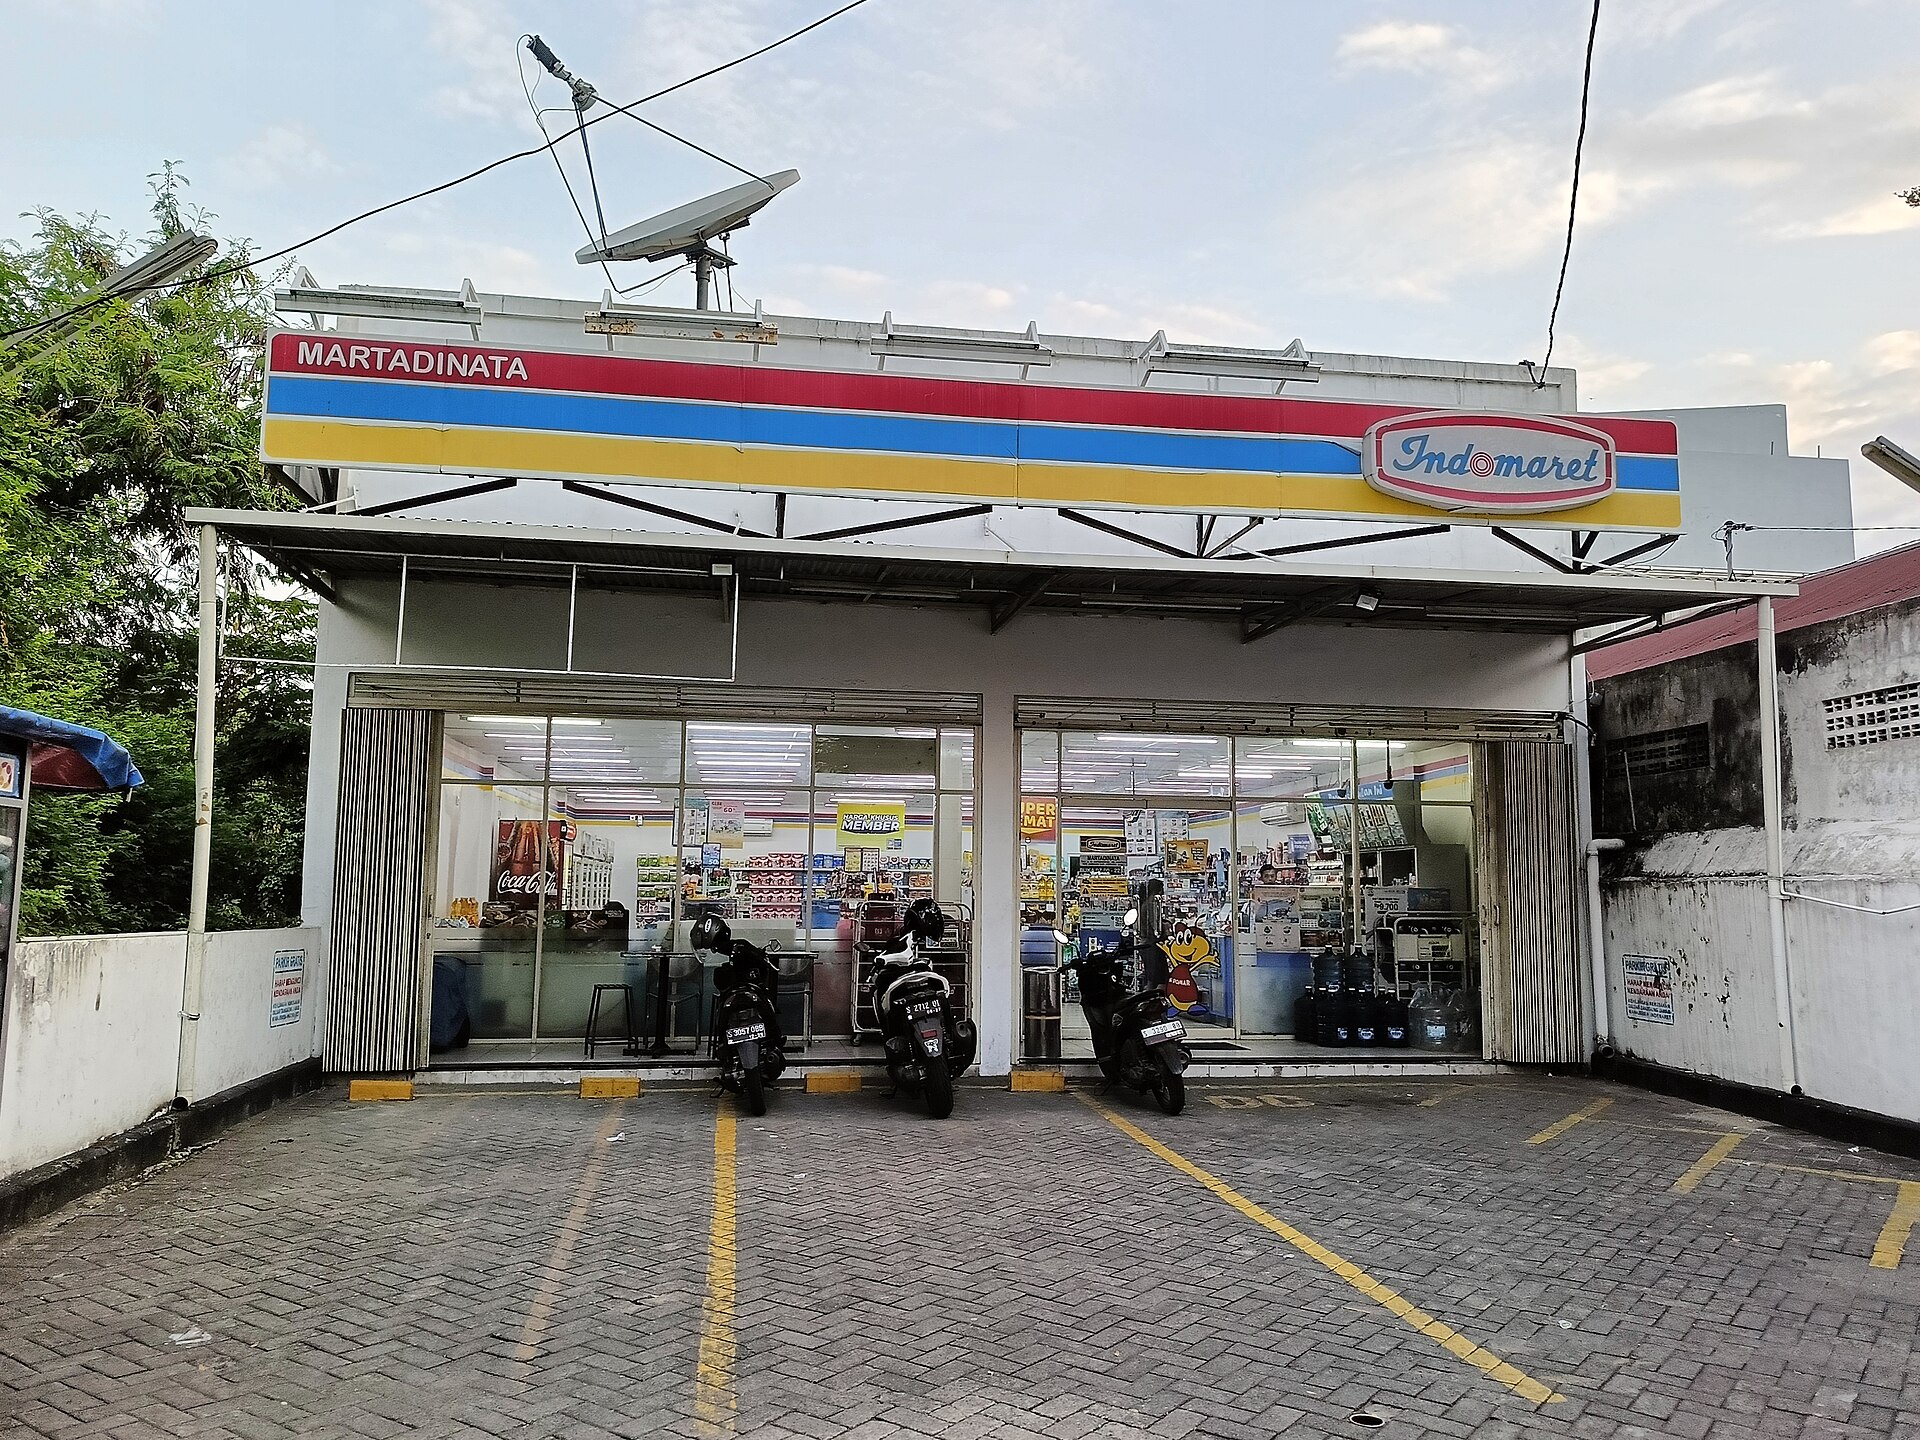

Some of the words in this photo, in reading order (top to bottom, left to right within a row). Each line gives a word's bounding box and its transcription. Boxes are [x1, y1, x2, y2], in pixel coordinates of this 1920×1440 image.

[297, 341, 528, 381] MARTADINATA
[1392, 434, 1599, 482] Indomaret
[842, 820, 900, 831] MEMBER
[275, 957, 289, 969] PARKIR
[290, 955, 303, 967] GRATIS
[1625, 960, 1645, 971] PARKIR
[1645, 962, 1668, 974] GRATIS
[906, 1006, 911, 1014] S
[913, 1001, 930, 1012] 2712
